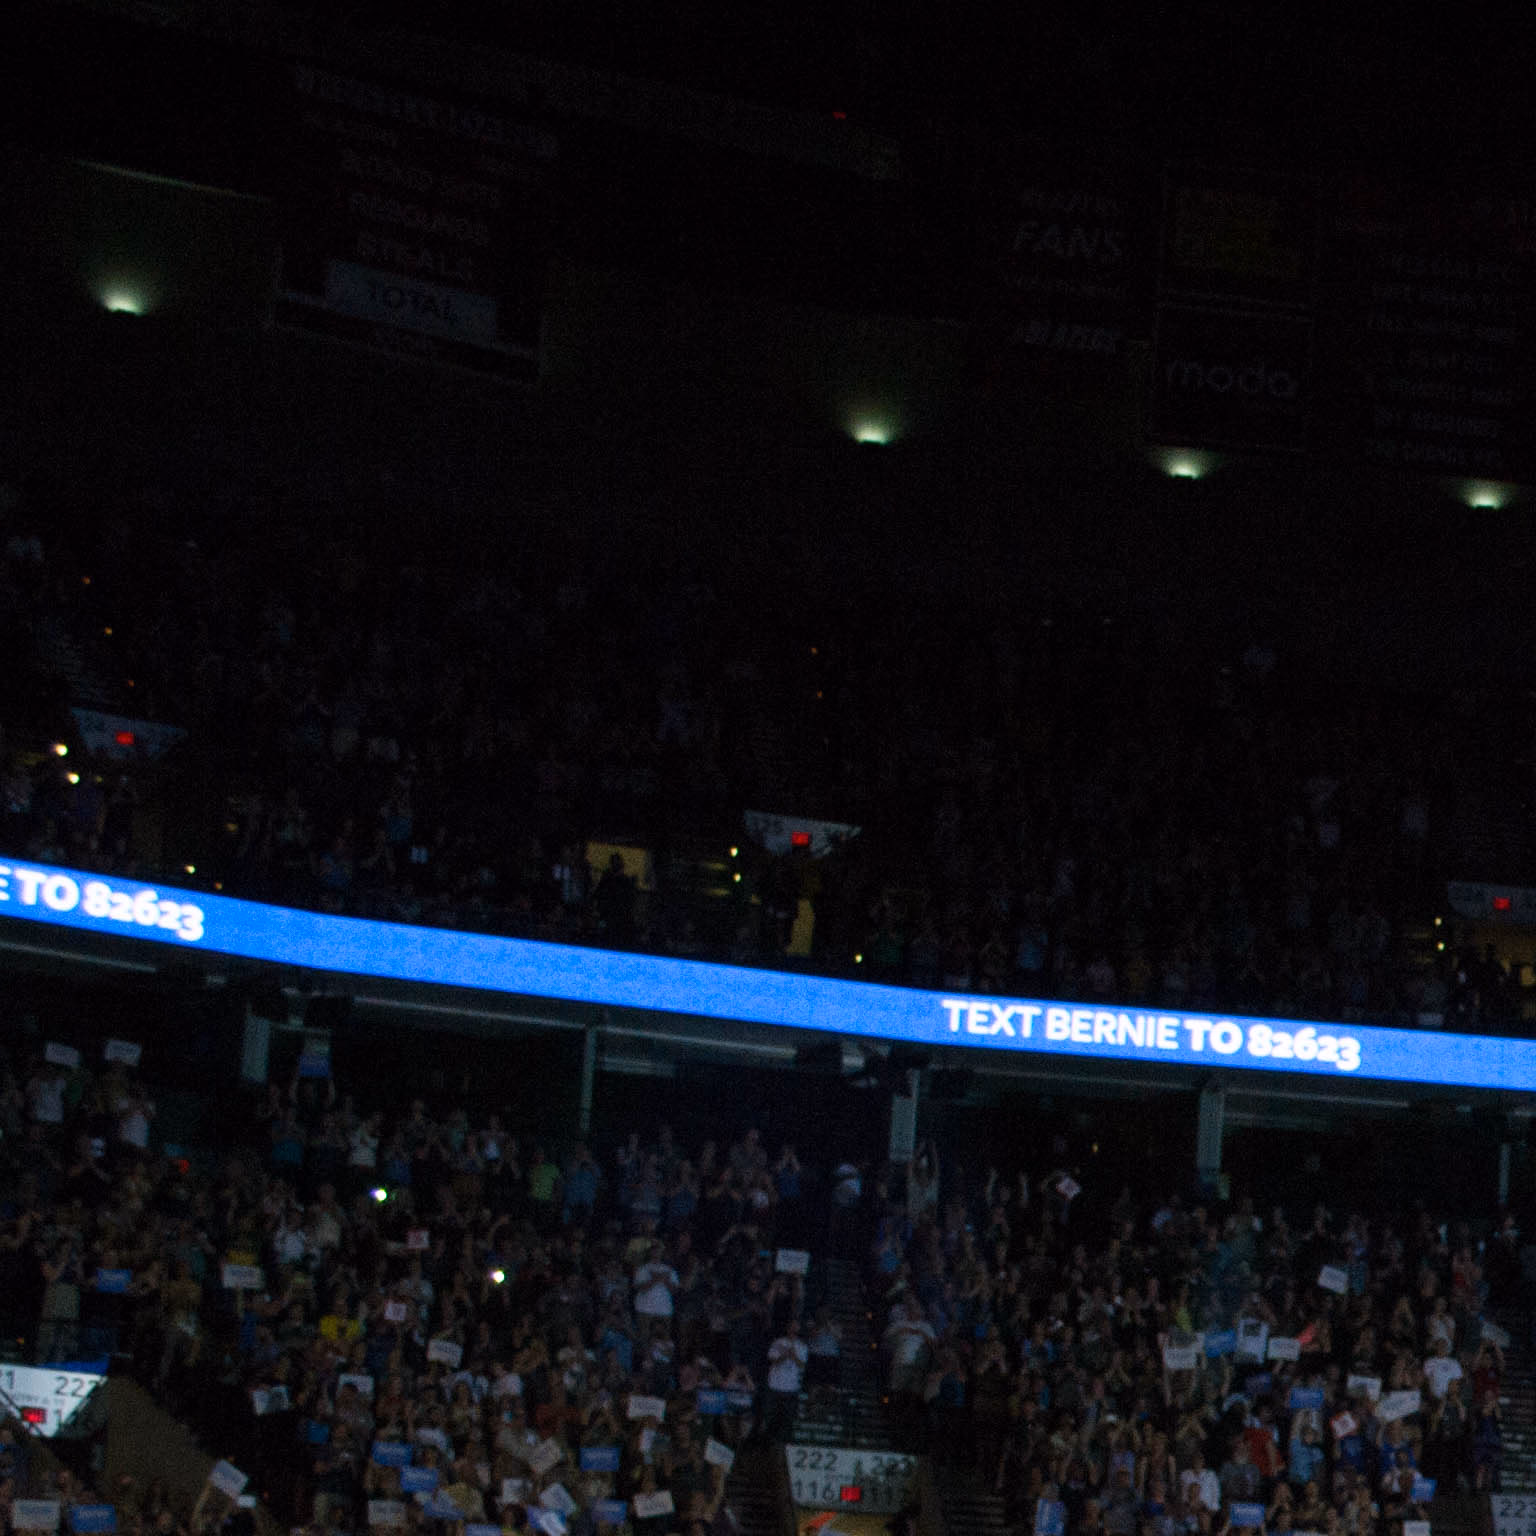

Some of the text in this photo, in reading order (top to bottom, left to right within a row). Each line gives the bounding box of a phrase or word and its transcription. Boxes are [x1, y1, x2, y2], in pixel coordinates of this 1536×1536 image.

[13, 867, 80, 912] TO
[81, 881, 204, 942] 82623
[940, 998, 1361, 1072] TEXT BERNIE TO 82623
